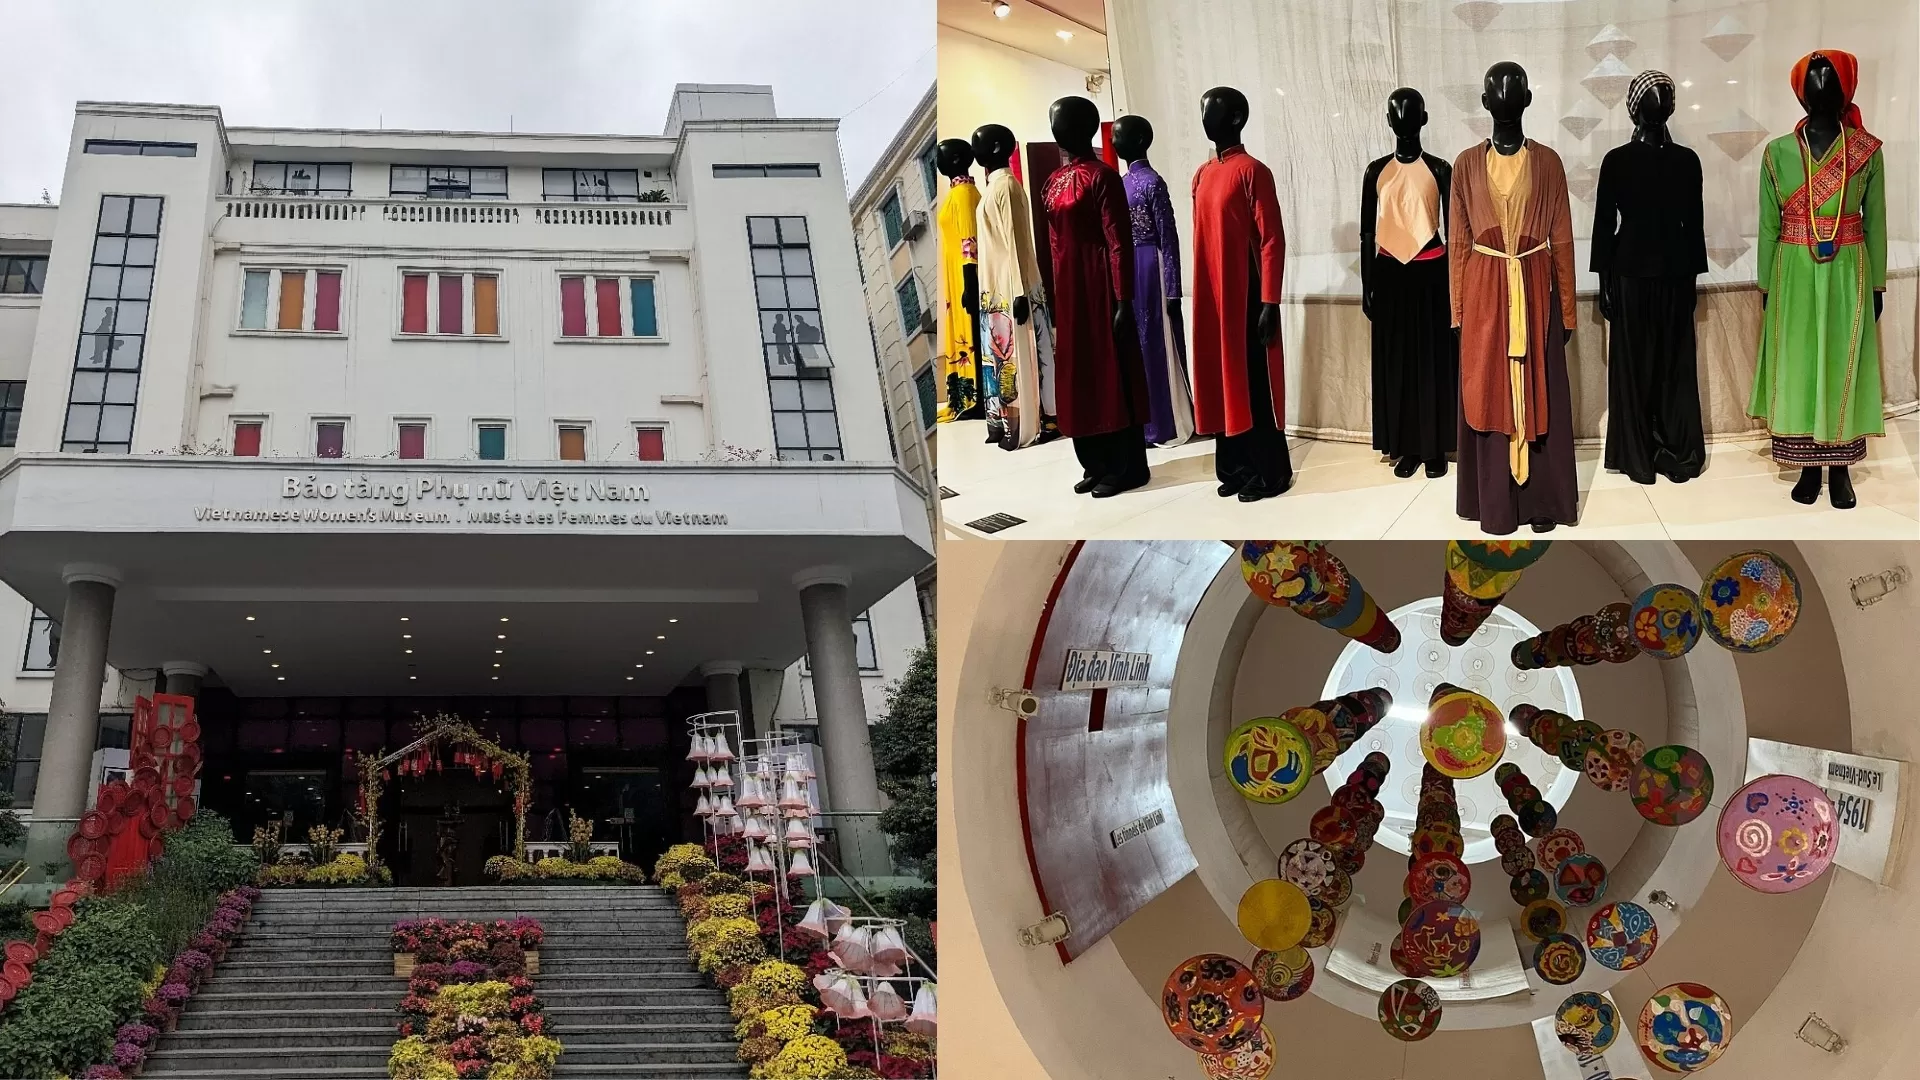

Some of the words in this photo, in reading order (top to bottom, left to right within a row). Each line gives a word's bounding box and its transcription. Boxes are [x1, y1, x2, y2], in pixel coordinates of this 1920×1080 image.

[282, 473, 338, 499] Bảo
[343, 473, 409, 506] tàng
[416, 475, 470, 507] Phụ
[477, 477, 514, 500] nữ
[520, 478, 578, 507] Việt
[585, 478, 650, 501] Nam
[194, 506, 300, 522] Vietnamese
[302, 507, 377, 523] Women's
[379, 509, 450, 523] Museum
[467, 509, 522, 524] Musée
[524, 510, 554, 525] des
[558, 509, 628, 525] Femmes
[631, 510, 653, 526] du
[655, 509, 729, 526] Vietnam
[1066, 651, 1087, 688] Địa
[1087, 651, 1107, 688] đạo
[1108, 653, 1130, 682] Vĩnh
[1129, 653, 1150, 682] Linh
[1872, 772, 1881, 791] Le
[1837, 792, 1865, 830] 1954
